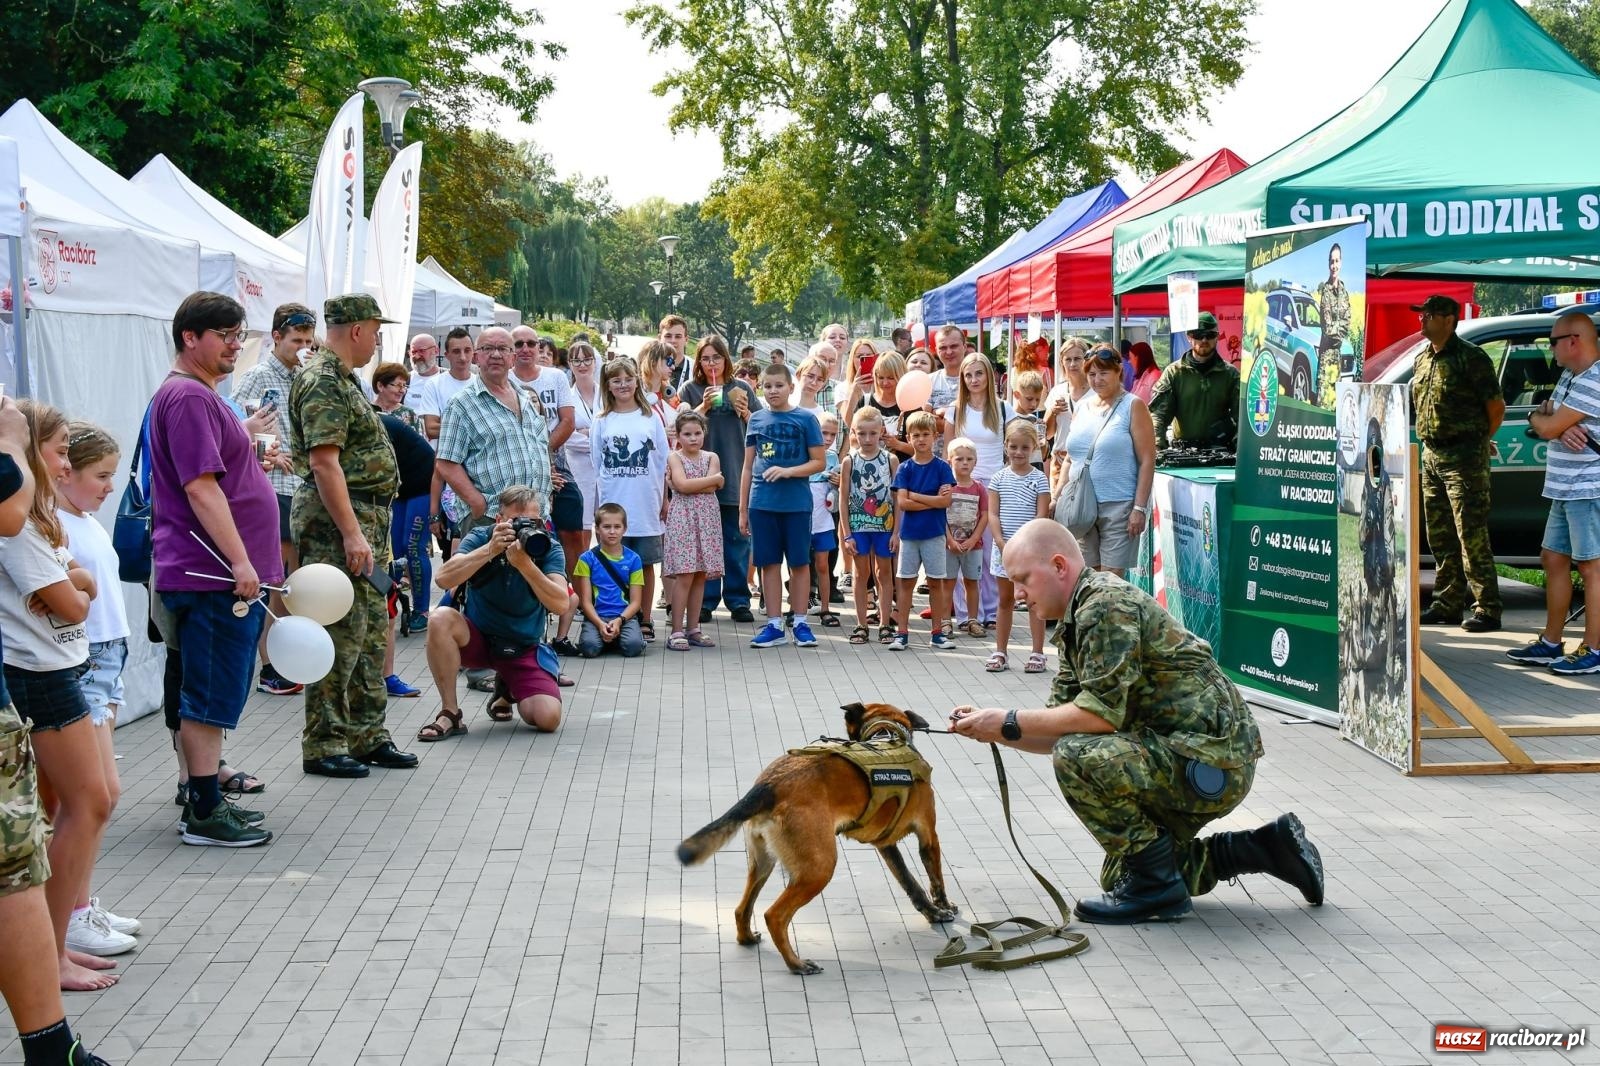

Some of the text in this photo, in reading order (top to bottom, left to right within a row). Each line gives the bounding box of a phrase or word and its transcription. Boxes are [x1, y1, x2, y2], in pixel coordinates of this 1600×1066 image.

[1424, 196, 1563, 236] ODDZIAŁ
[58, 240, 97, 266] Racibórz
[1277, 420, 1338, 442] ŚLĄSKI ODDZIAŁ
[1260, 444, 1336, 466] STRAŻY GRANICZNEJ
[1281, 485, 1335, 504] W RACIBORZU
[1265, 532, 1332, 556] +48 32 414 44 14
